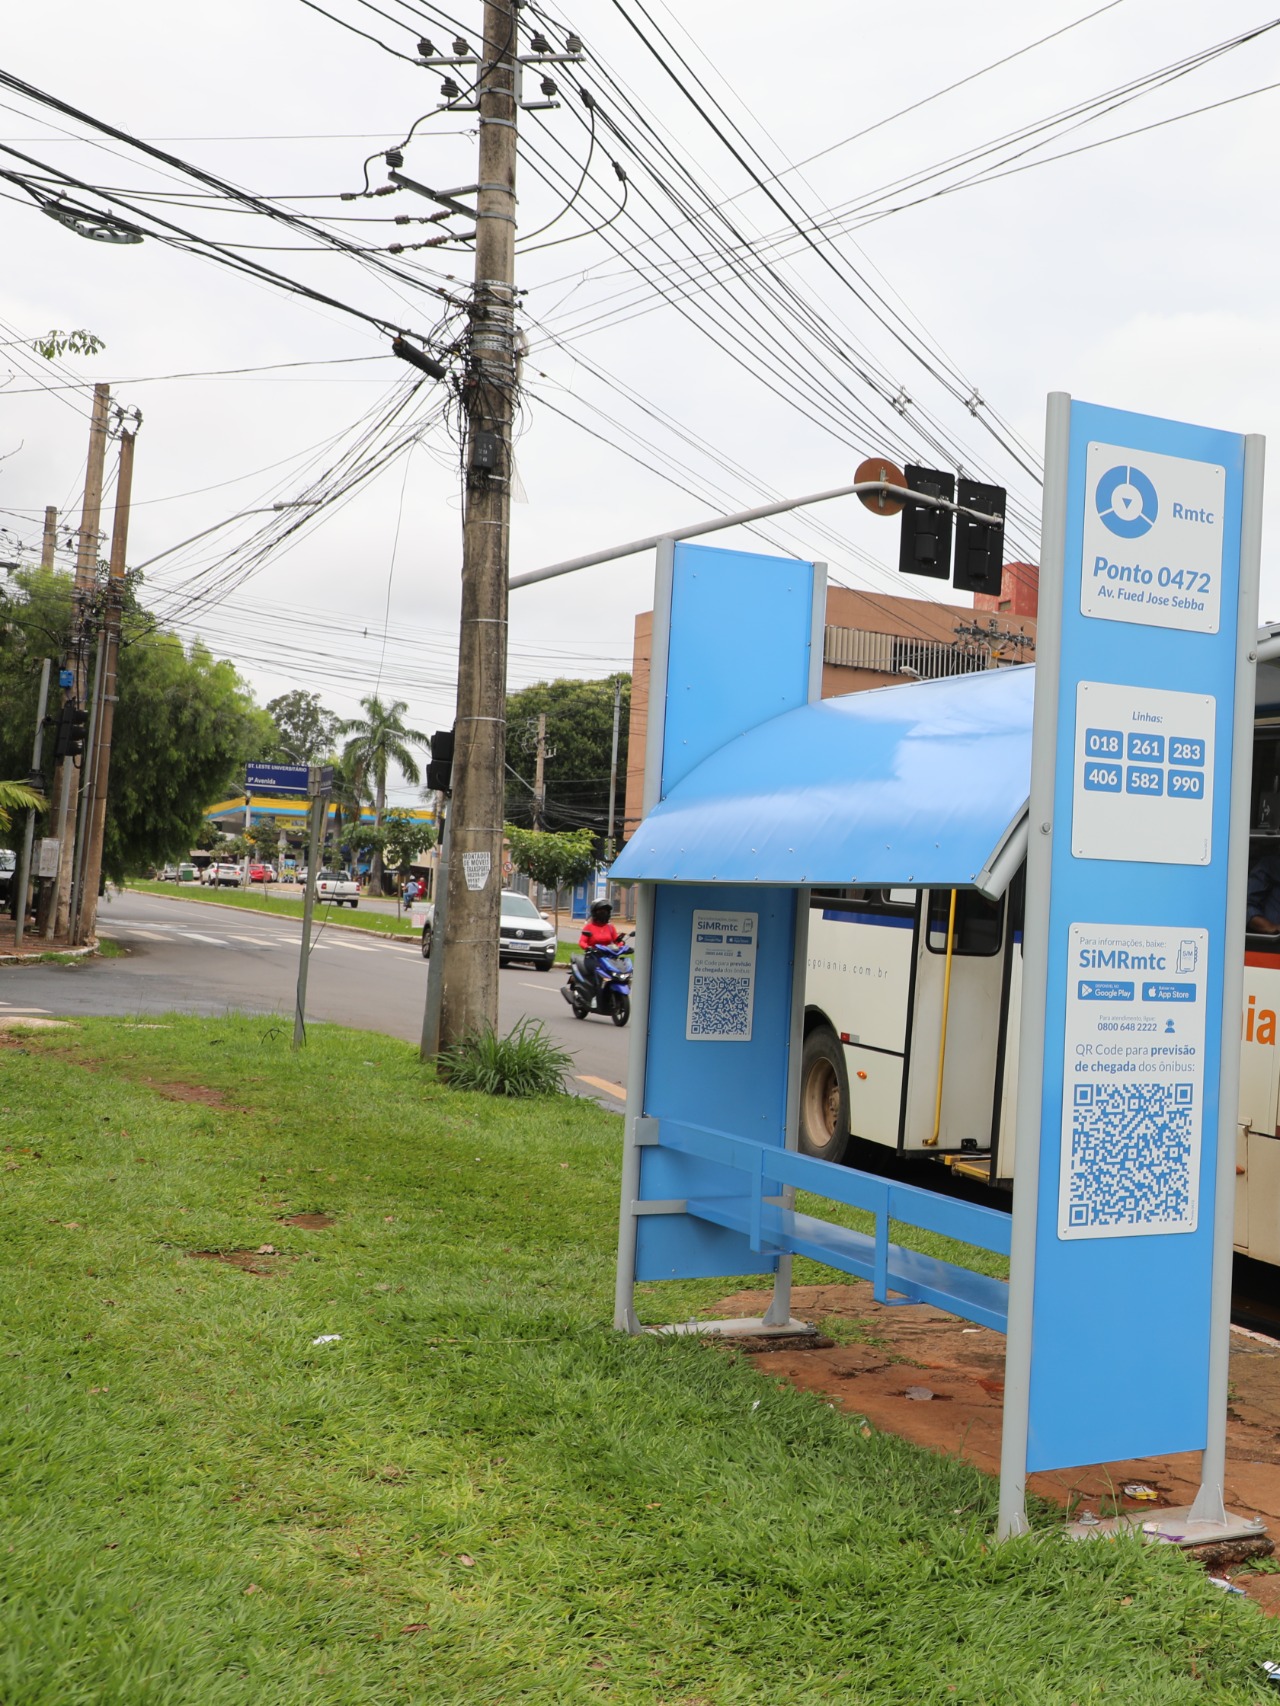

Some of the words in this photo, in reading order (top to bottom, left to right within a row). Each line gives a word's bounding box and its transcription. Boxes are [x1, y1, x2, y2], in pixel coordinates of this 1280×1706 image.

[1173, 502, 1215, 525] Rmtc
[1093, 556, 1153, 585] Ponto
[1158, 567, 1211, 594] 0472
[1097, 585, 1115, 599] Av.
[1117, 588, 1144, 603] Fued
[1146, 592, 1169, 606] Jose
[1171, 596, 1205, 611] Sebba
[1132, 711, 1163, 723] Linhas:
[1090, 735, 1119, 752] 018
[1132, 739, 1160, 756] 261
[1173, 743, 1201, 760] 283
[254, 777, 276, 785] Avenida
[1088, 769, 1118, 785] 406
[1131, 772, 1159, 789] 582
[1172, 776, 1200, 793] 990
[697, 921, 738, 931] SiMRmtc
[1079, 937, 1097, 945] Para
[1098, 937, 1145, 948] informações,
[1145, 940, 1167, 948] baixe:
[1079, 949, 1167, 970] SiMRmtc
[1095, 989, 1117, 998] Google
[1118, 989, 1131, 998] Play
[1158, 991, 1171, 999] App
[1097, 1022, 1119, 1031] 0800
[1120, 1022, 1135, 1031] 648
[1137, 1023, 1157, 1032] 2222
[1075, 1044, 1093, 1057] QR
[1095, 1044, 1123, 1055] Code
[1125, 1046, 1148, 1057] para
[1150, 1045, 1195, 1057] previsão
[1075, 1061, 1088, 1072] de
[1090, 1061, 1136, 1074] chegada
[1138, 1061, 1156, 1072] dos
[1159, 1061, 1195, 1072] ônibus:
